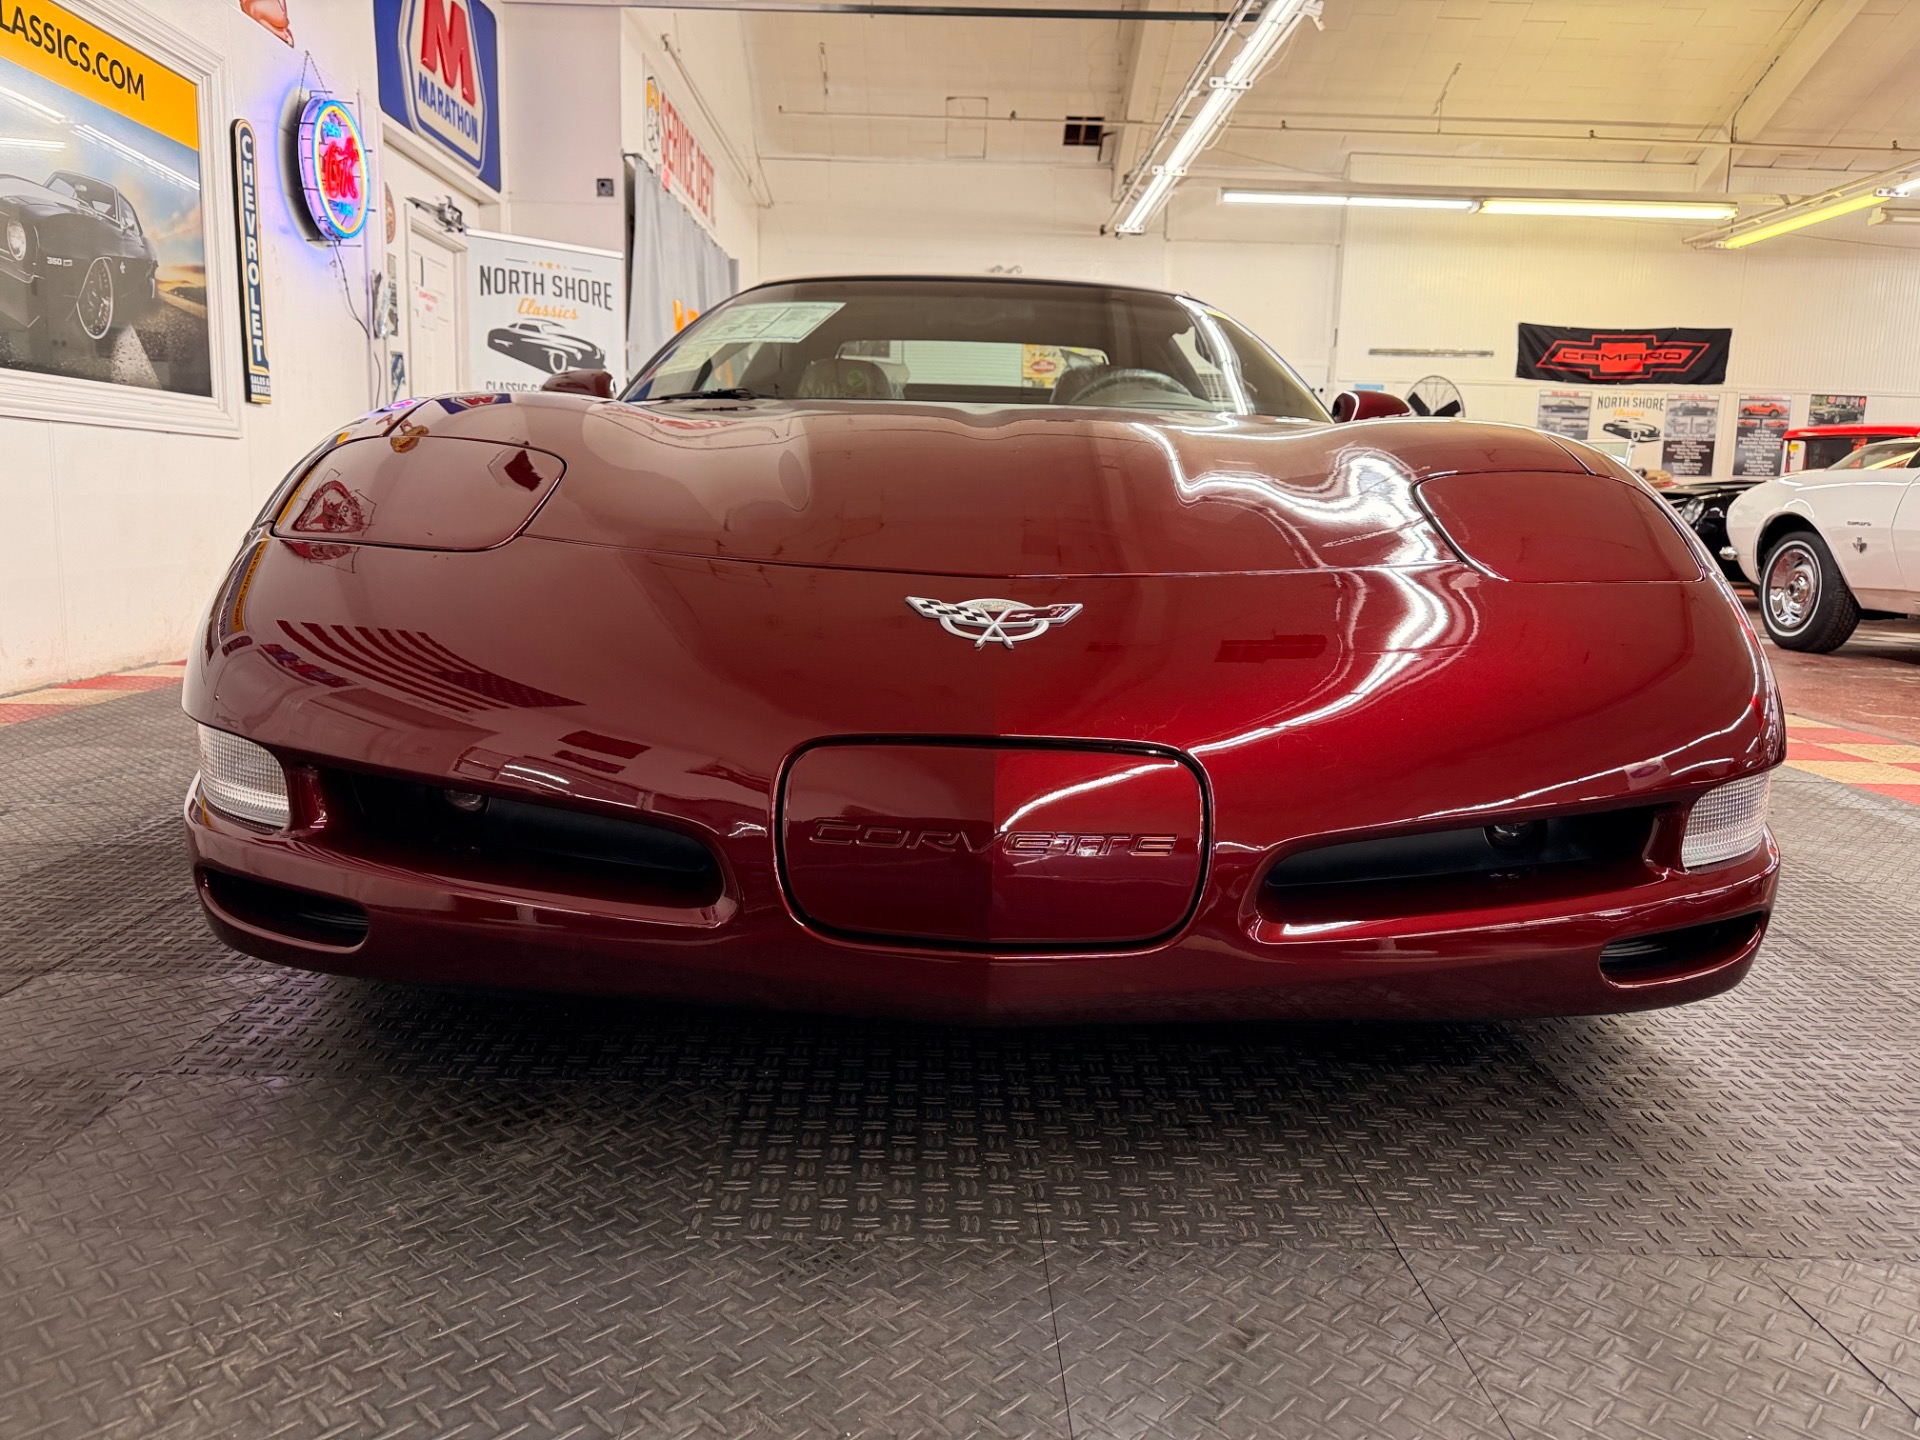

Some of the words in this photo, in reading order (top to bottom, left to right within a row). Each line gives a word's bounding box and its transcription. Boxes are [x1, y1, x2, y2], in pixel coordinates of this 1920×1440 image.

[418, 71, 478, 144] MARATHON
[661, 90, 694, 200] SERVICE
[46, 256, 63, 266] 350
[240, 134, 264, 362] CHEVROLET
[480, 265, 545, 296] NORTH
[552, 275, 613, 312] SHORE
[517, 297, 579, 320] Classics
[1562, 351, 1682, 361] CAMARO
[1597, 396, 1630, 410] NORTH
[1633, 397, 1664, 411] SHORE
[808, 818, 1179, 857] CORVETTE
